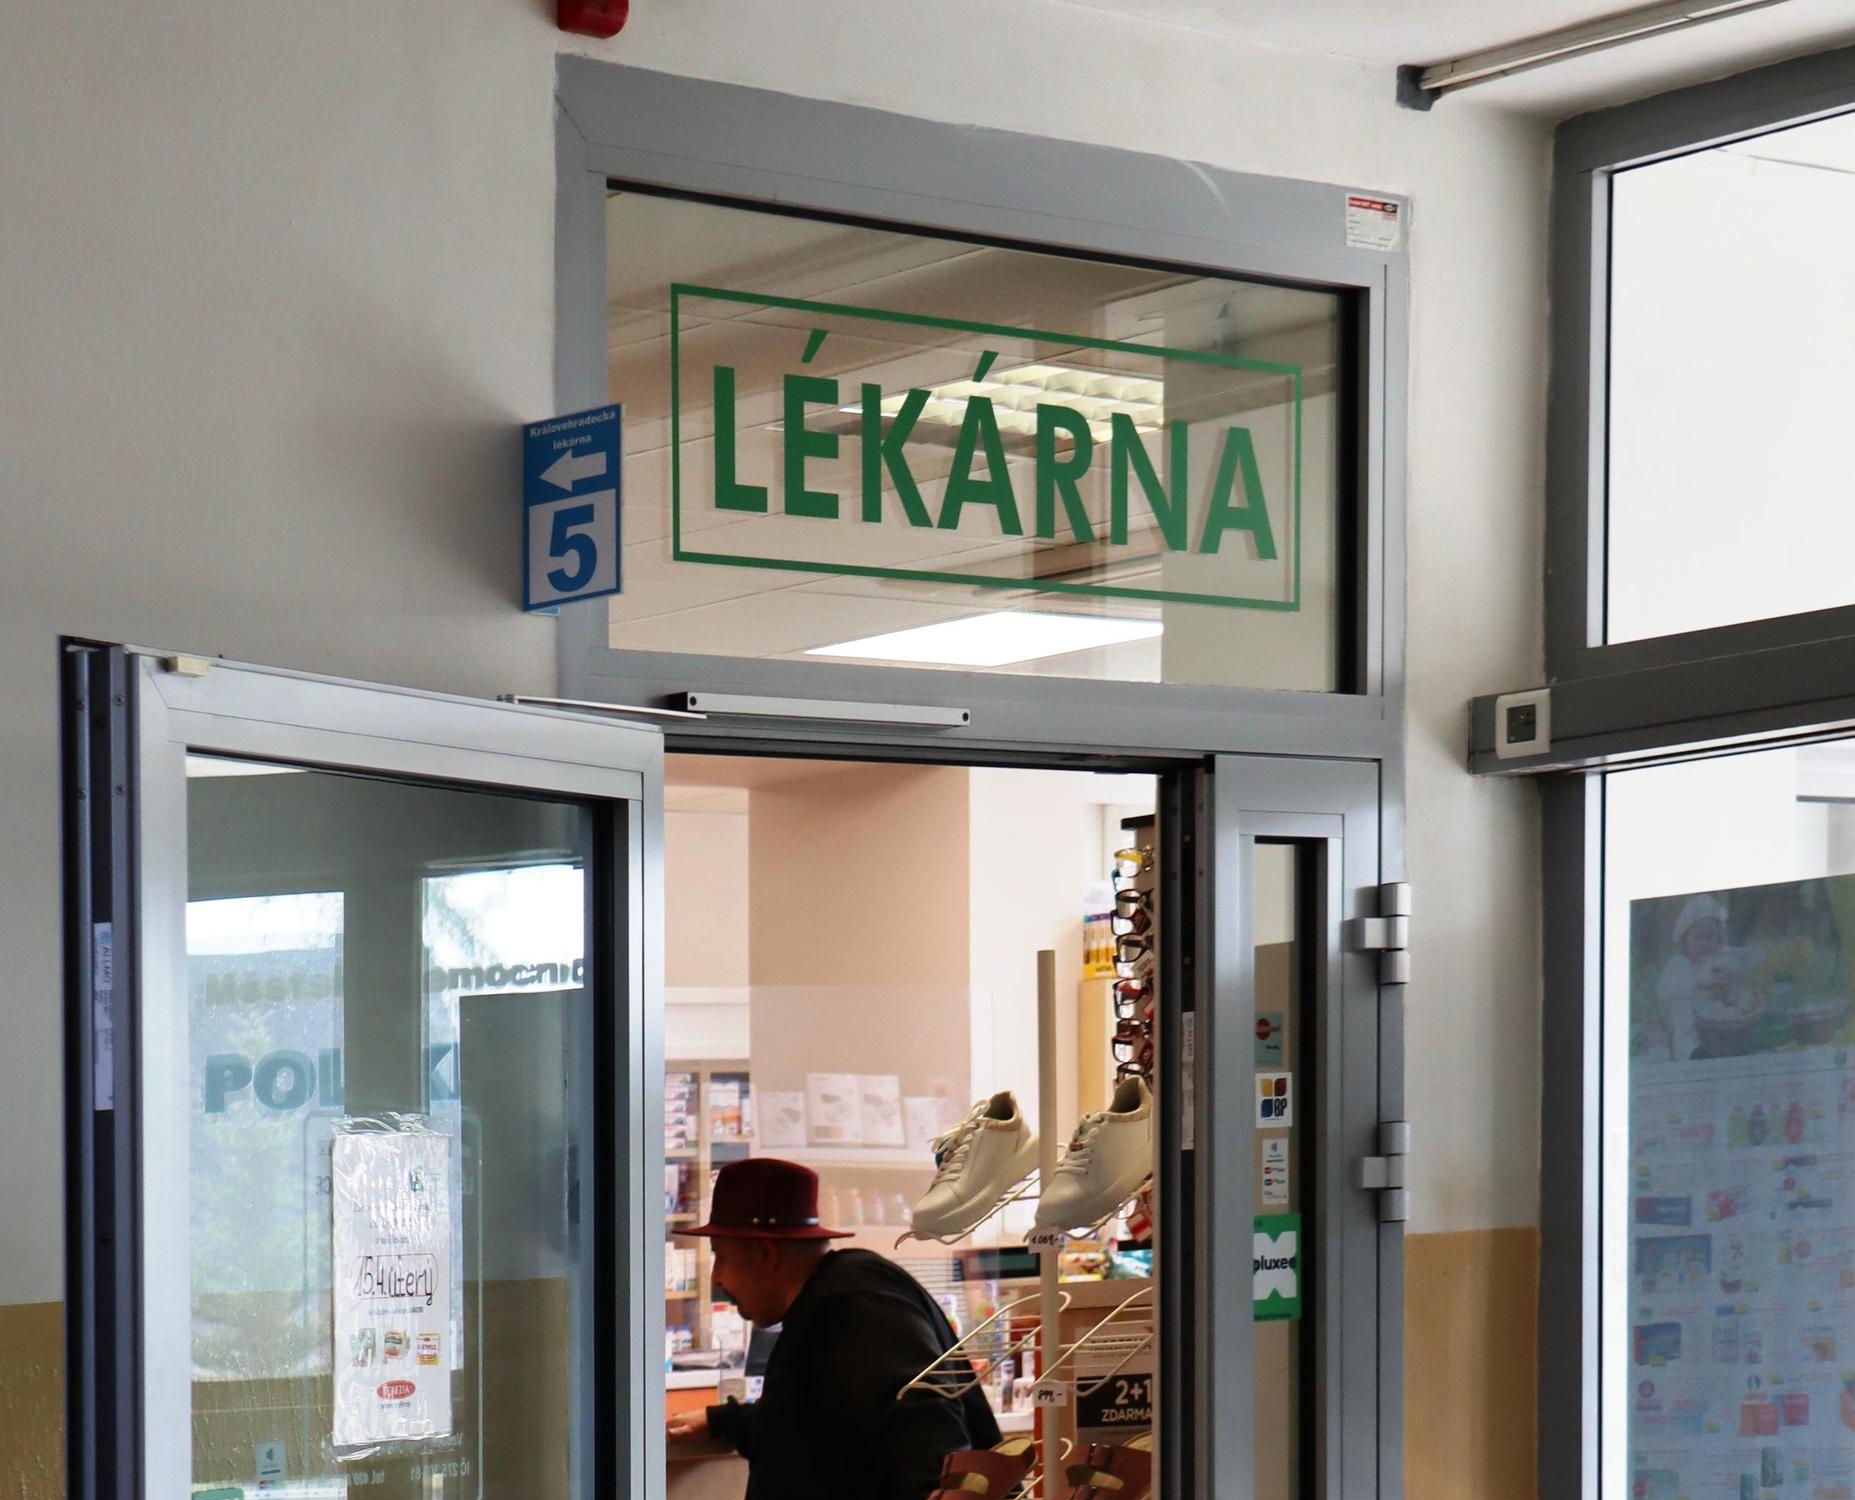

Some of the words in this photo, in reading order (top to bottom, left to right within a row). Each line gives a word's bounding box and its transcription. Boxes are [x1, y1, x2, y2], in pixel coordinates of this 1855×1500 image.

[529, 411, 616, 438] Královehradecká
[553, 433, 592, 450] lékárna
[713, 329, 1277, 560] LÉKÁRNA
[547, 503, 597, 592] 5
[1253, 1255, 1296, 1275] pluxee
[1101, 1408, 1151, 1422] ZDARMA
